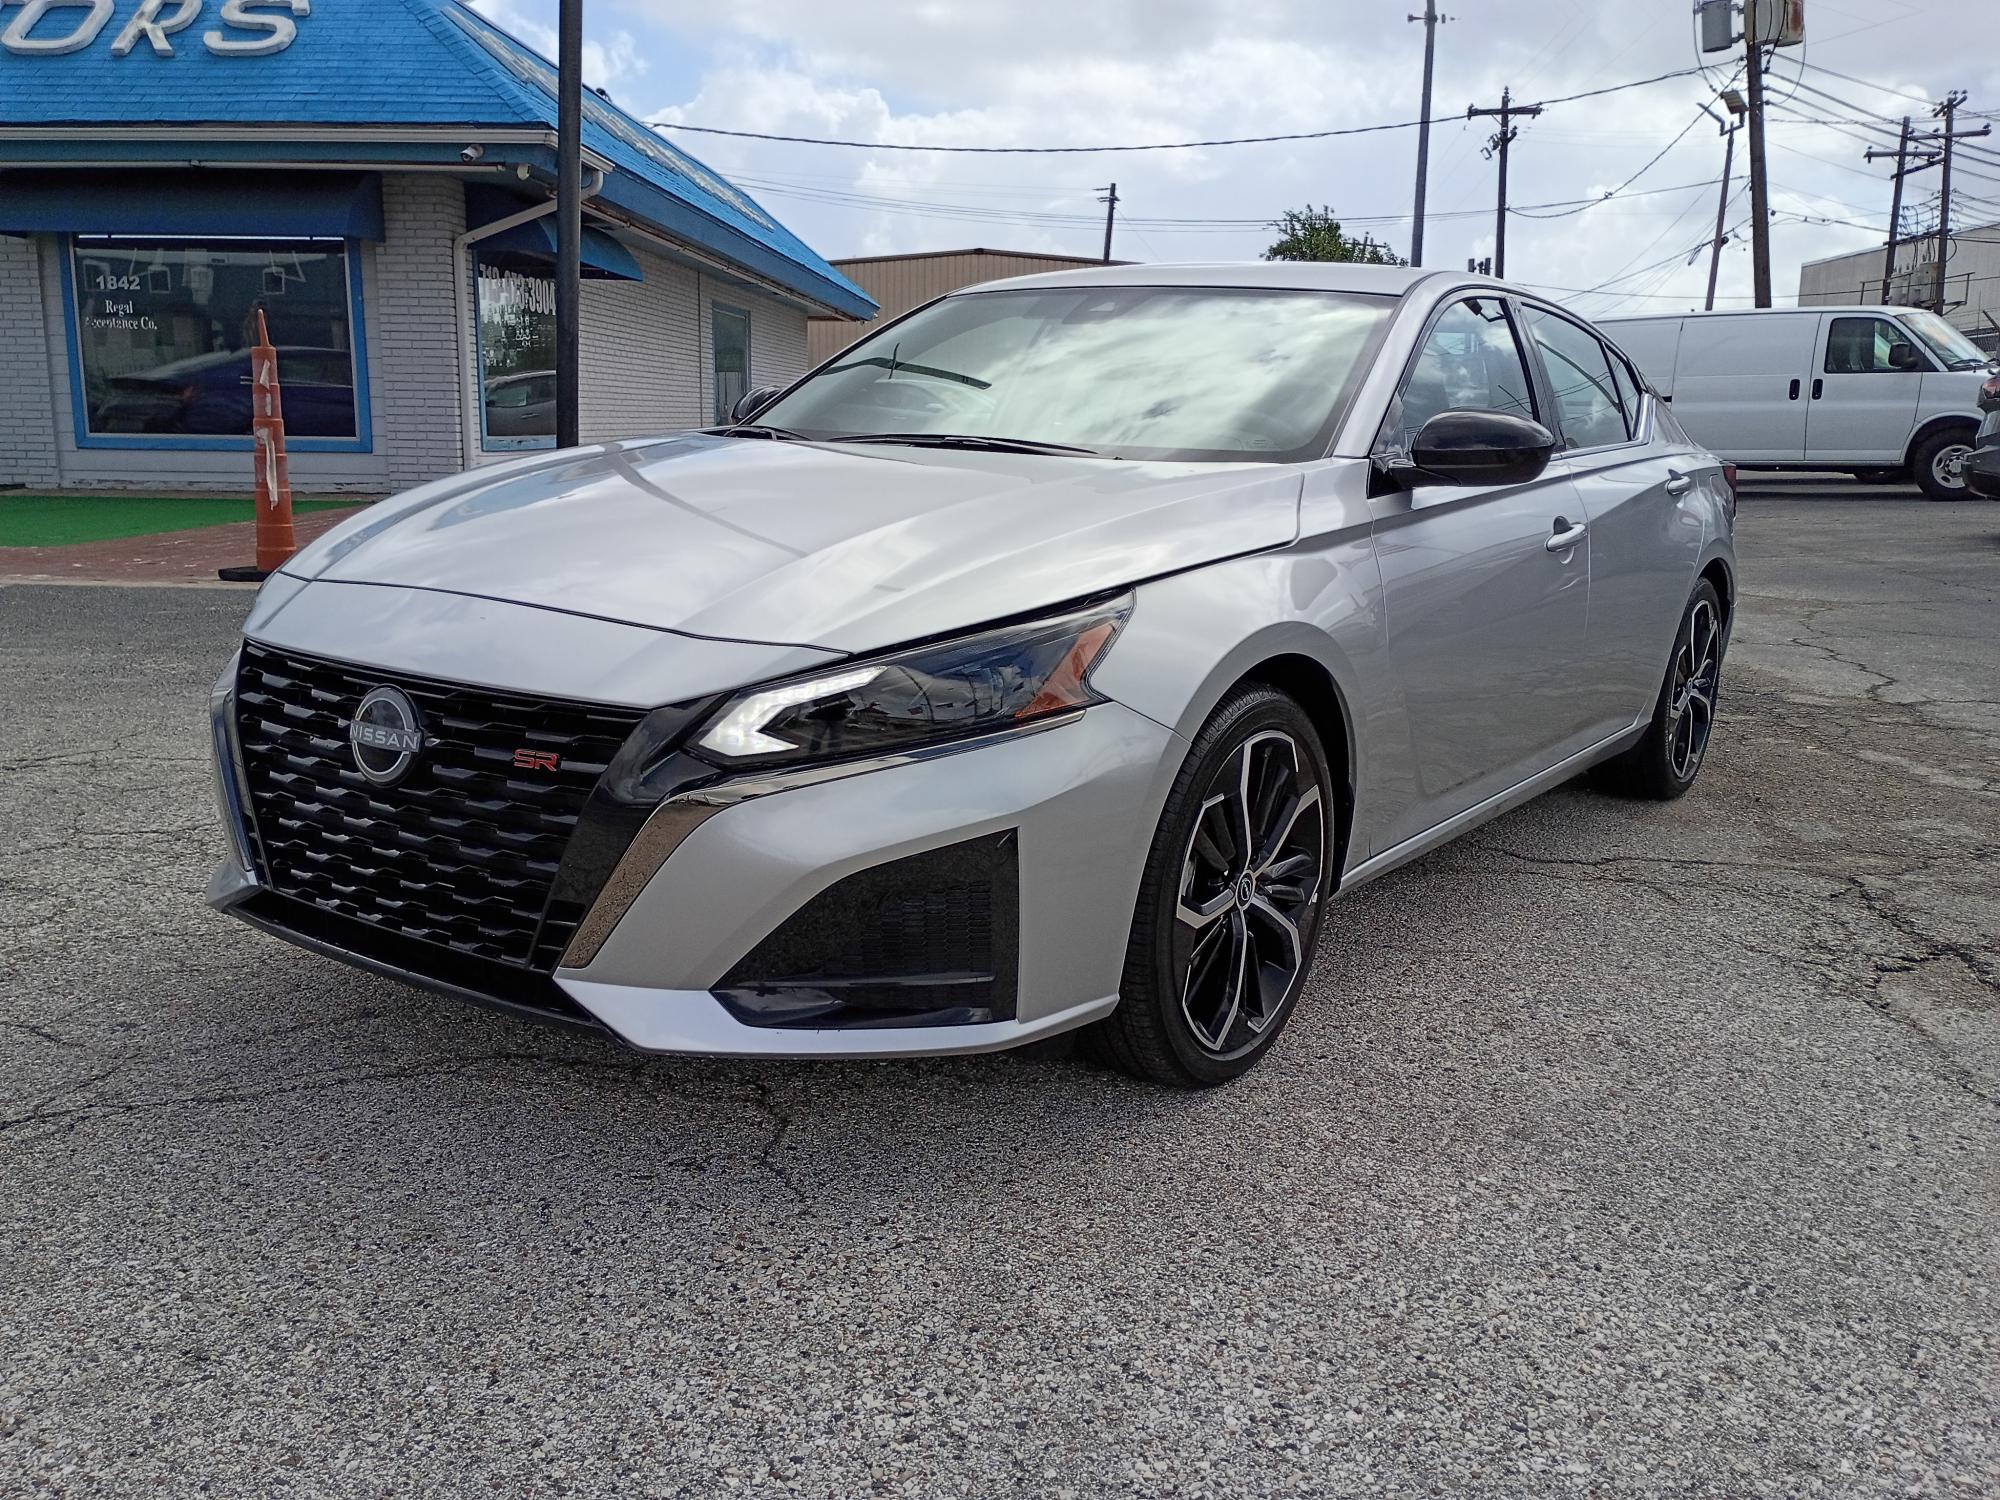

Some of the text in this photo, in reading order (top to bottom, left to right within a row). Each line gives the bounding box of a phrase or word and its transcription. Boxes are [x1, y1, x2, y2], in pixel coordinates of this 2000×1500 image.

[0, 0, 311, 56] ORS
[96, 275, 141, 290] 1842
[105, 300, 134, 317] Regal
[141, 316, 158, 330] Co.
[350, 723, 418, 750] NISSAN
[514, 748, 560, 772] SR
